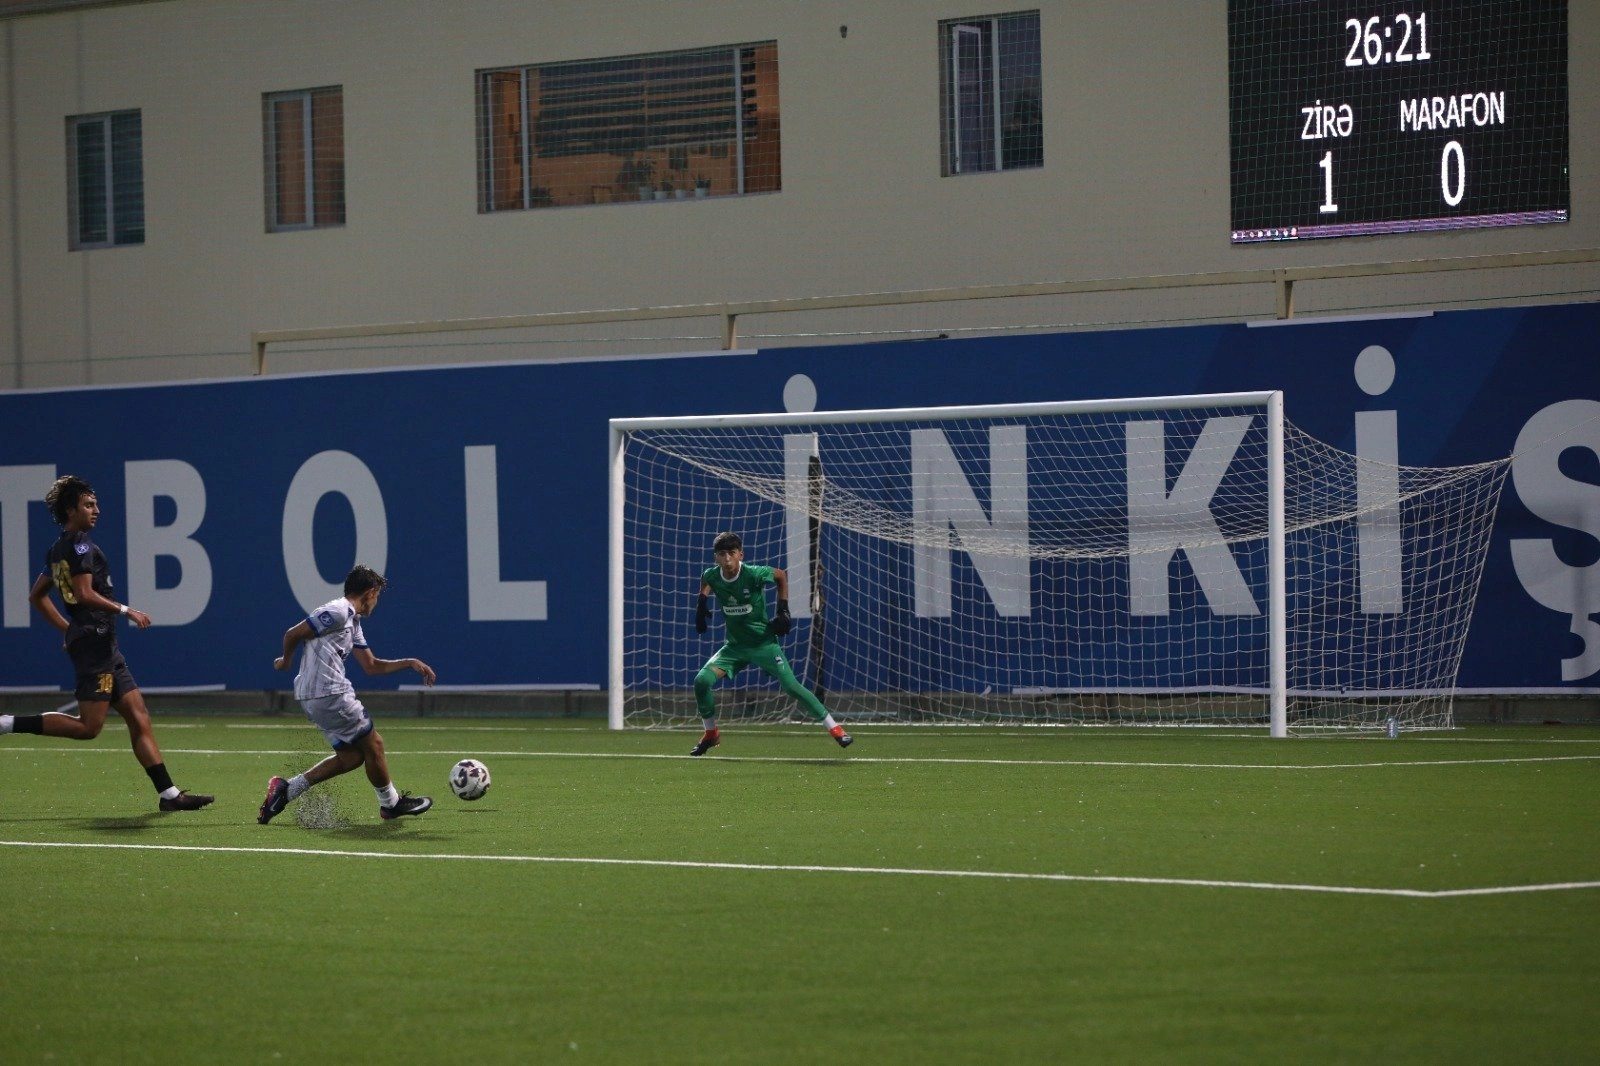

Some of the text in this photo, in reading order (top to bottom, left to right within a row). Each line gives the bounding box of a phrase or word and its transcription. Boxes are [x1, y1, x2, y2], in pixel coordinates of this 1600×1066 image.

[1346, 12, 1432, 67] 26:21
[1301, 90, 1506, 140] ZİRƏ MARAFON
[1319, 140, 1466, 214] 1 0
